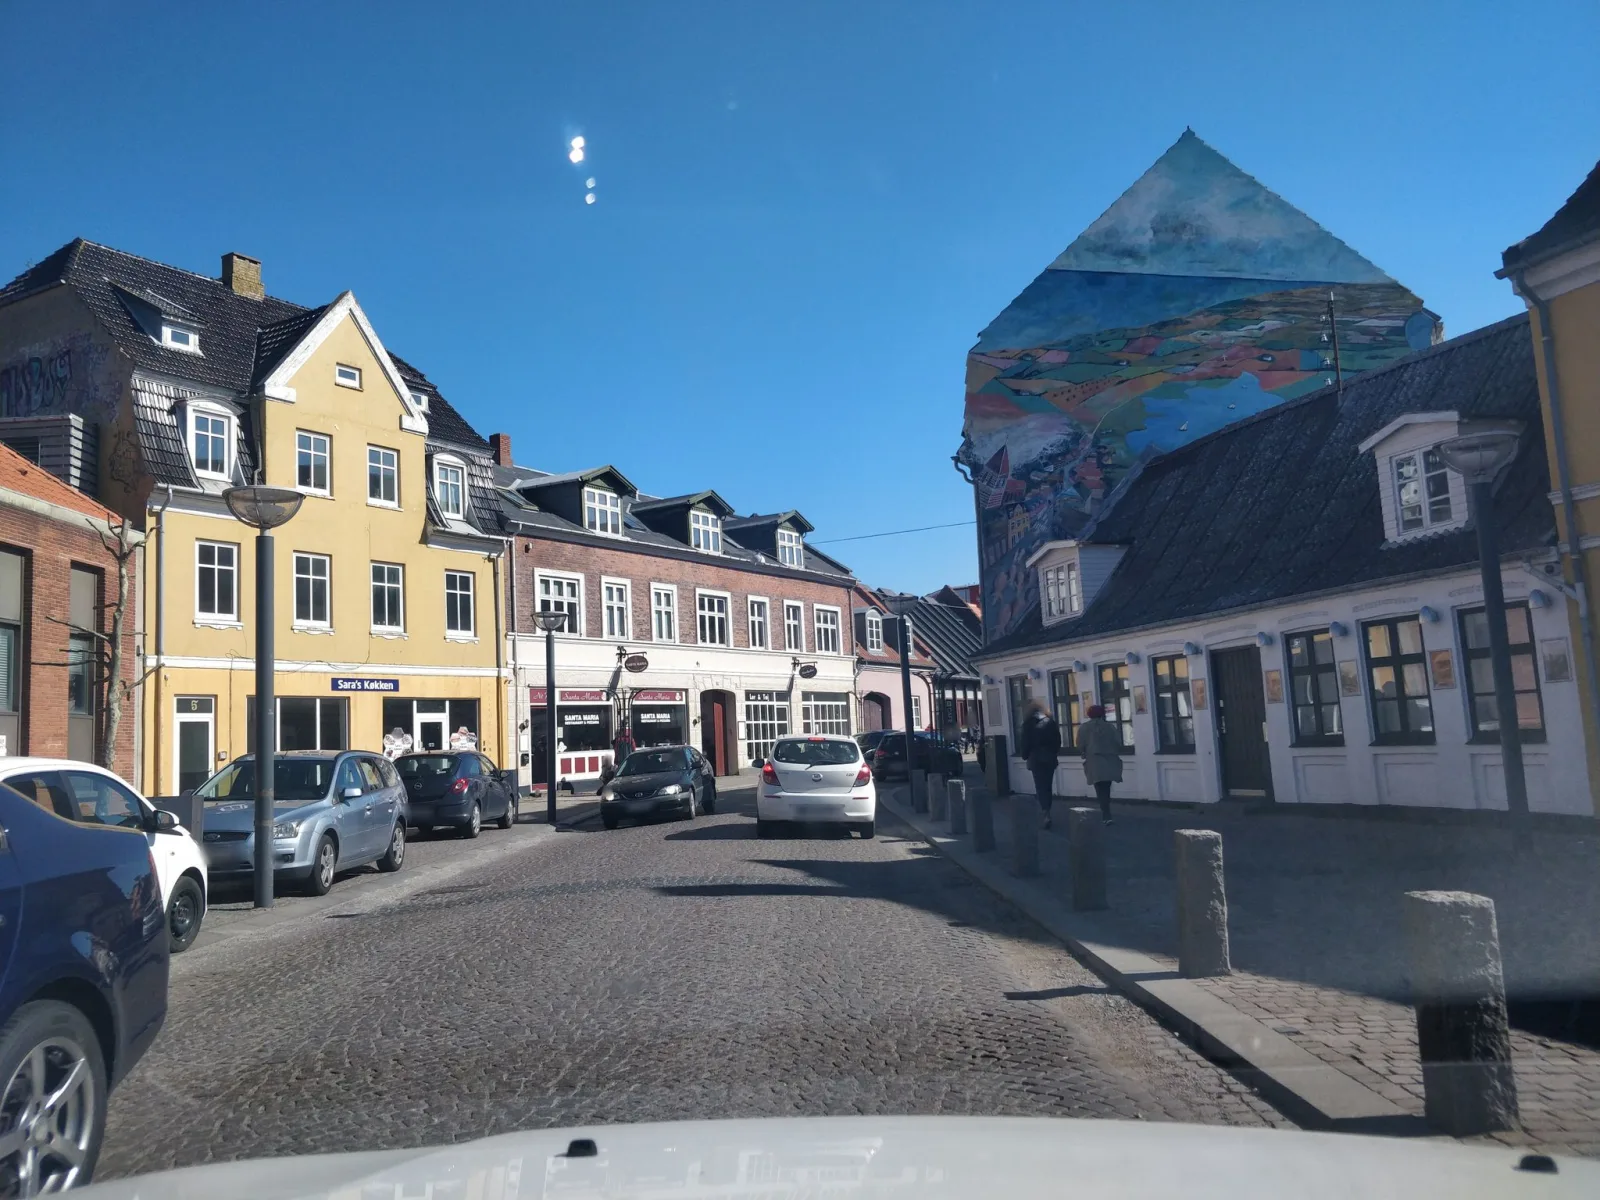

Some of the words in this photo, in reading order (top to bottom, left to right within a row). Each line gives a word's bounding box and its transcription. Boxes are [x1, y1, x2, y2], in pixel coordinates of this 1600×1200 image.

[337, 679, 362, 690] Sara's
[363, 680, 394, 690] Køkken
[562, 691, 580, 700] Santa
[581, 691, 600, 701] Maria
[638, 692, 653, 700] Santa
[654, 692, 670, 700] Maria
[191, 699, 199, 711] 5
